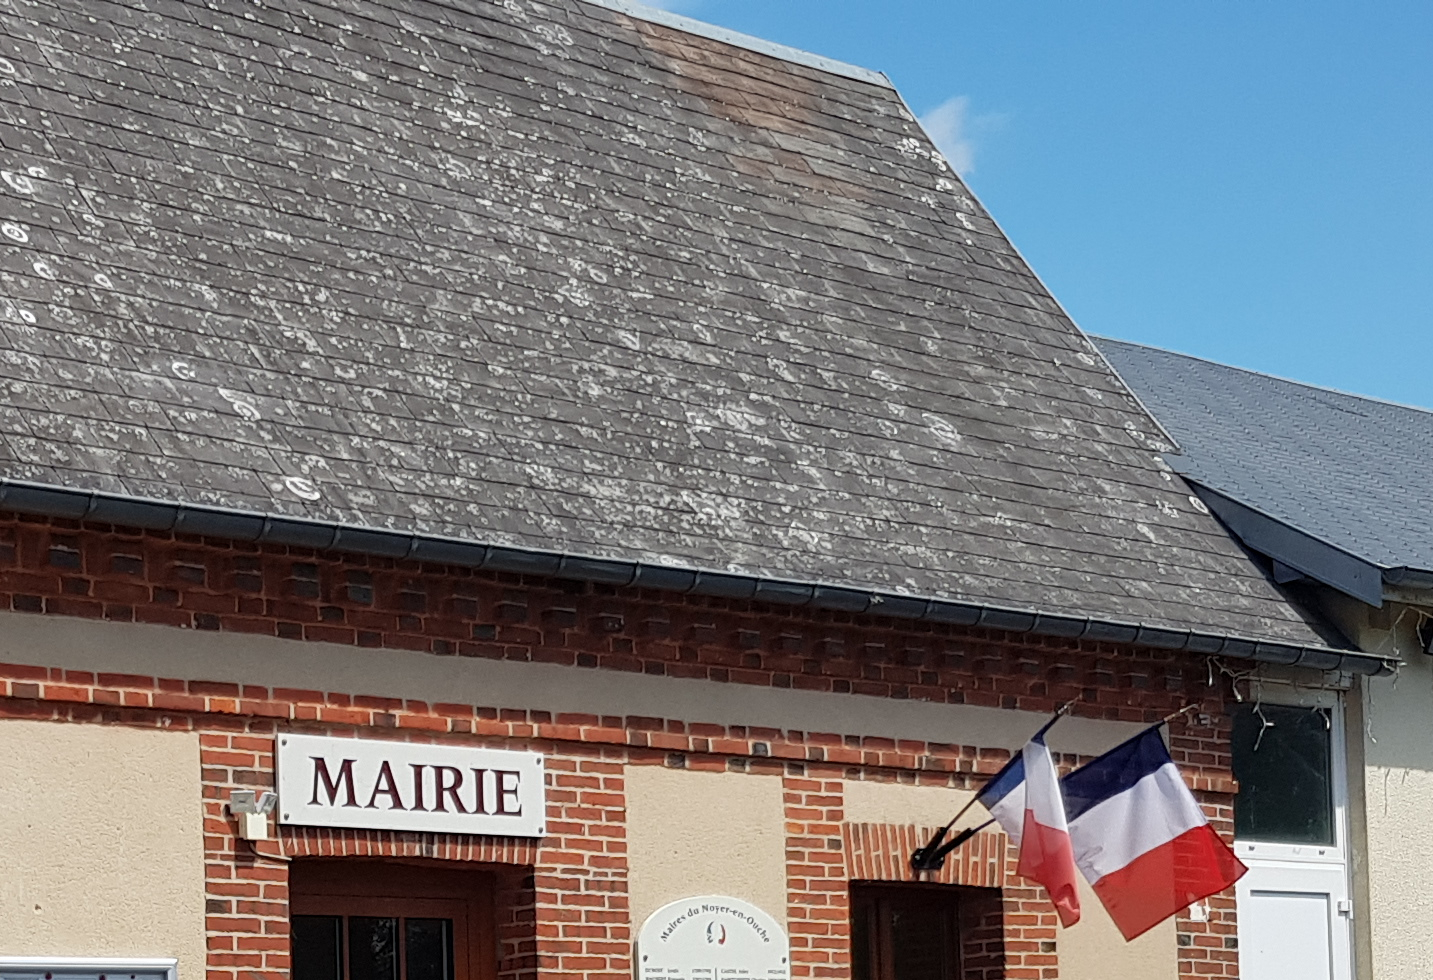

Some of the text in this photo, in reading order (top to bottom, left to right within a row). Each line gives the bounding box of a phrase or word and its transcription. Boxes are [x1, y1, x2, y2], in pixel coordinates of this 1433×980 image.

[307, 756, 522, 817] MAIRIE
[660, 903, 770, 943] Maires du Noyer-en-Ouche
